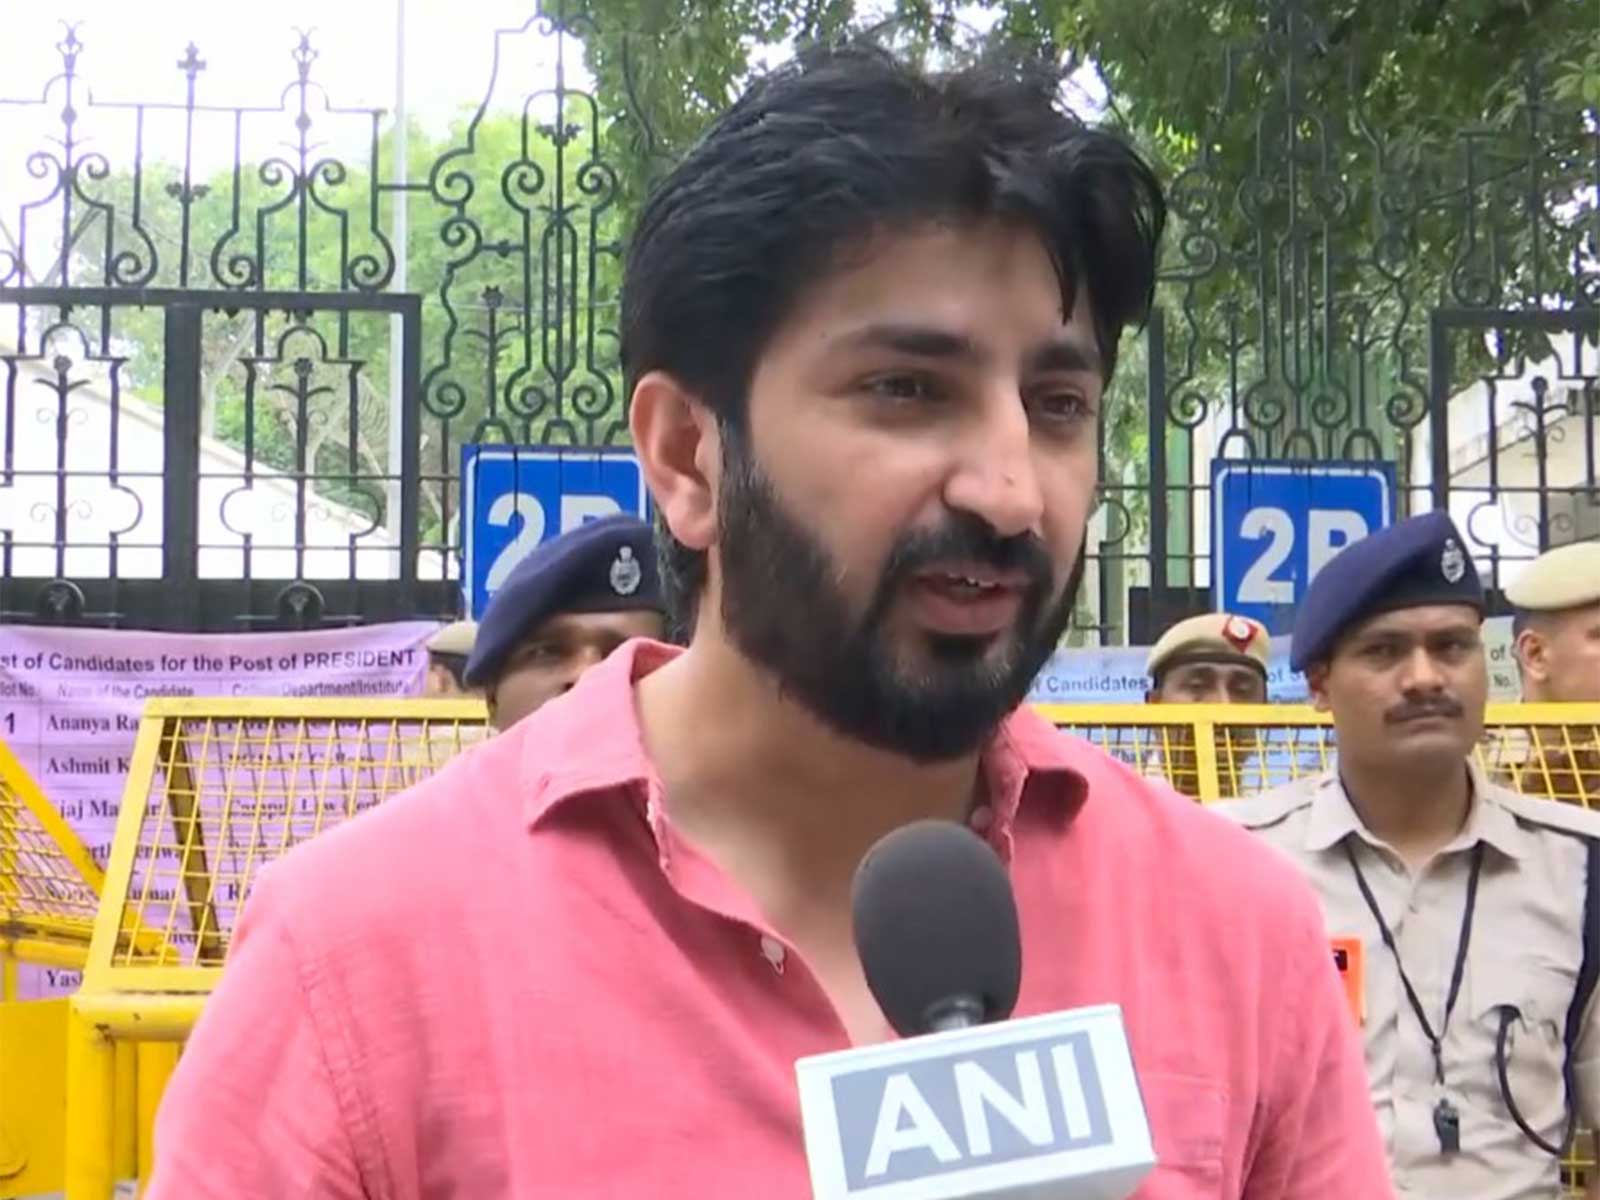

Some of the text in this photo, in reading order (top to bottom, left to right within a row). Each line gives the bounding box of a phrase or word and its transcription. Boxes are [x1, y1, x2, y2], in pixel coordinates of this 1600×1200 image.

[486, 492, 622, 592] 2
[24, 653, 43, 669] of
[49, 653, 155, 672] Candidates
[161, 654, 187, 672] for
[192, 654, 224, 672] the
[229, 655, 273, 672] Post
[278, 653, 297, 671] of
[303, 649, 415, 669] PRESIDENT
[1490, 644, 1506, 661] of
[134, 683, 194, 699] Candidate
[1046, 675, 1149, 693] Candidates
[4, 712, 15, 734] 1
[46, 714, 110, 734] Ananya
[46, 757, 110, 774] Ashmit
[865, 1042, 1092, 1178] ANI
